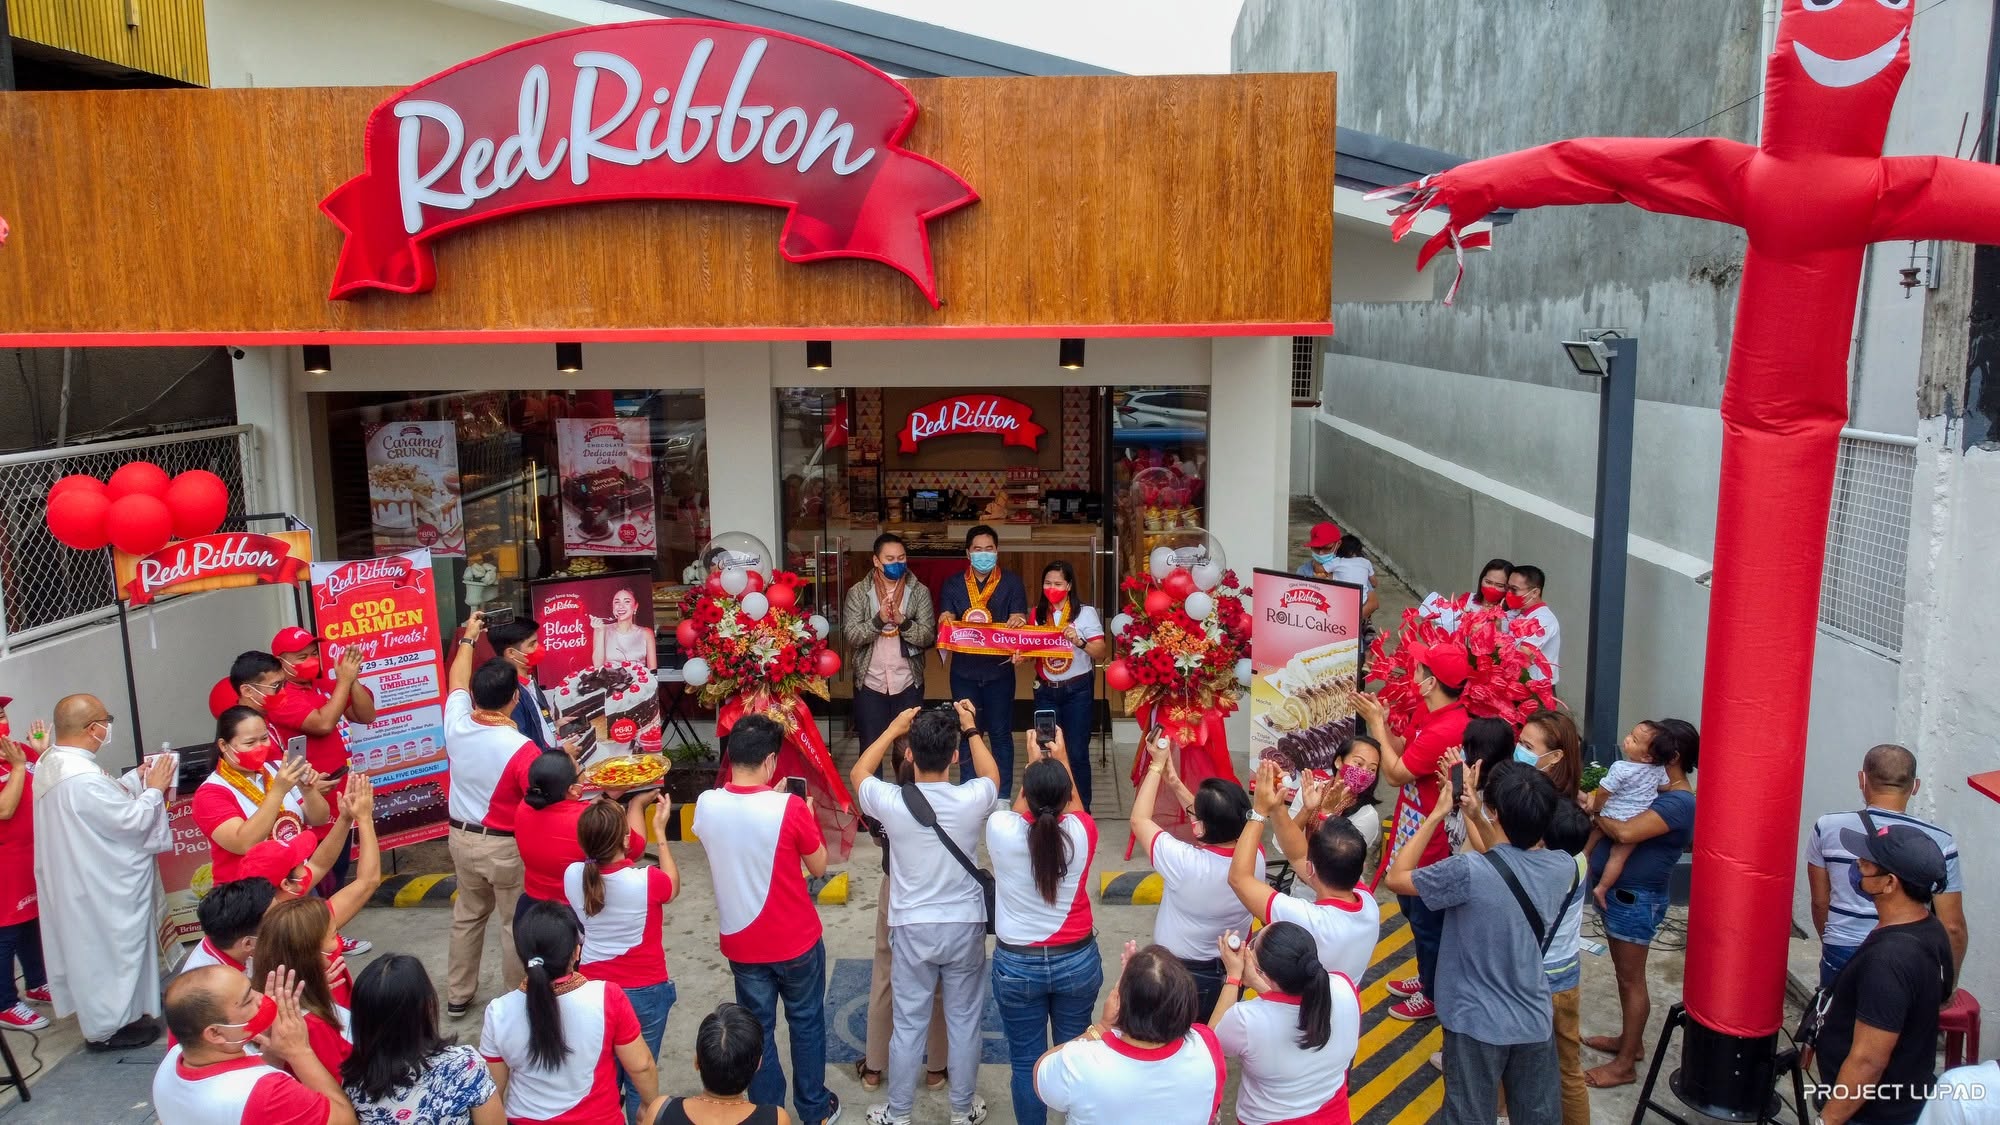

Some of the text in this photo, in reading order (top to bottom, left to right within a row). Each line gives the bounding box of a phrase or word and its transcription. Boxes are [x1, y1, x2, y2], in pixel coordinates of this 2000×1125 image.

[394, 37, 876, 234] Red Ribbon
[911, 400, 1020, 442] Red Ribbon
[382, 435, 446, 451] Caramel
[386, 447, 440, 460] CRUNCH
[582, 449, 628, 458] Dedication
[596, 457, 617, 465] Cake
[139, 536, 279, 593] Red Ribbon
[327, 560, 406, 597] Red Ribbon
[1284, 590, 1324, 606] Red Ribbon
[350, 597, 396, 619] CDO
[544, 600, 580, 616] Red Ribbon
[324, 608, 424, 640] CARMEN
[543, 619, 585, 637] Black
[1266, 607, 1347, 636] ROLL Cakes
[381, 626, 428, 648] Treats!
[543, 634, 588, 652] Forest
[991, 632, 1017, 644] Give
[1018, 634, 1041, 646] love
[1042, 634, 1073, 648] today
[366, 661, 377, 670] 29
[398, 653, 420, 664] 2022
[379, 672, 402, 683] FREE
[380, 675, 430, 691] UMBRELLA
[367, 714, 413, 730] FREE MUG
[800, 732, 816, 755] Give
[382, 774, 396, 782] ALL
[396, 772, 410, 780] FIVE
[410, 764, 440, 776] DESIGNS!
[409, 790, 431, 803] Open!
[170, 826, 203, 841] Trea
